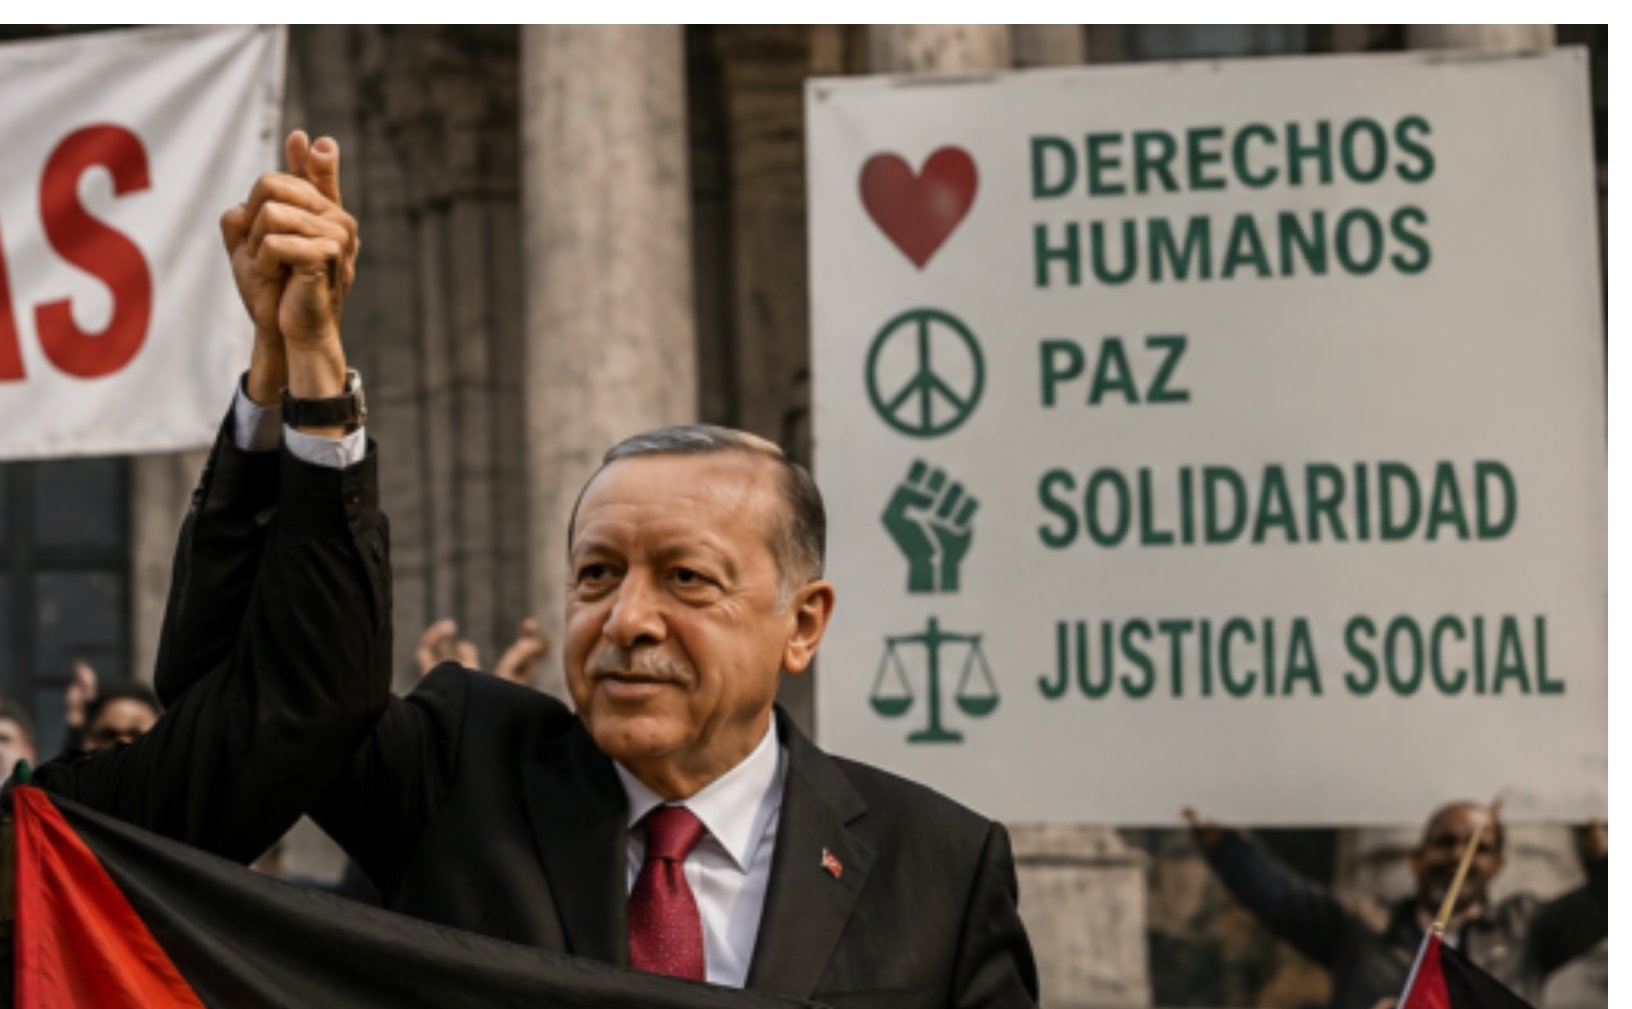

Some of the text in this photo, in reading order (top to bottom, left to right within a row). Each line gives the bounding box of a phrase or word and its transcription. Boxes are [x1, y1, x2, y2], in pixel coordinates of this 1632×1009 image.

[1031, 116, 1435, 198] DERECHOS
[1035, 206, 1430, 287] HUMANOS
[1040, 336, 1189, 407] PAZ
[1039, 462, 1516, 548] SOLIDARIDAD
[1039, 616, 1564, 699] JUSTICIA SOCIAL
